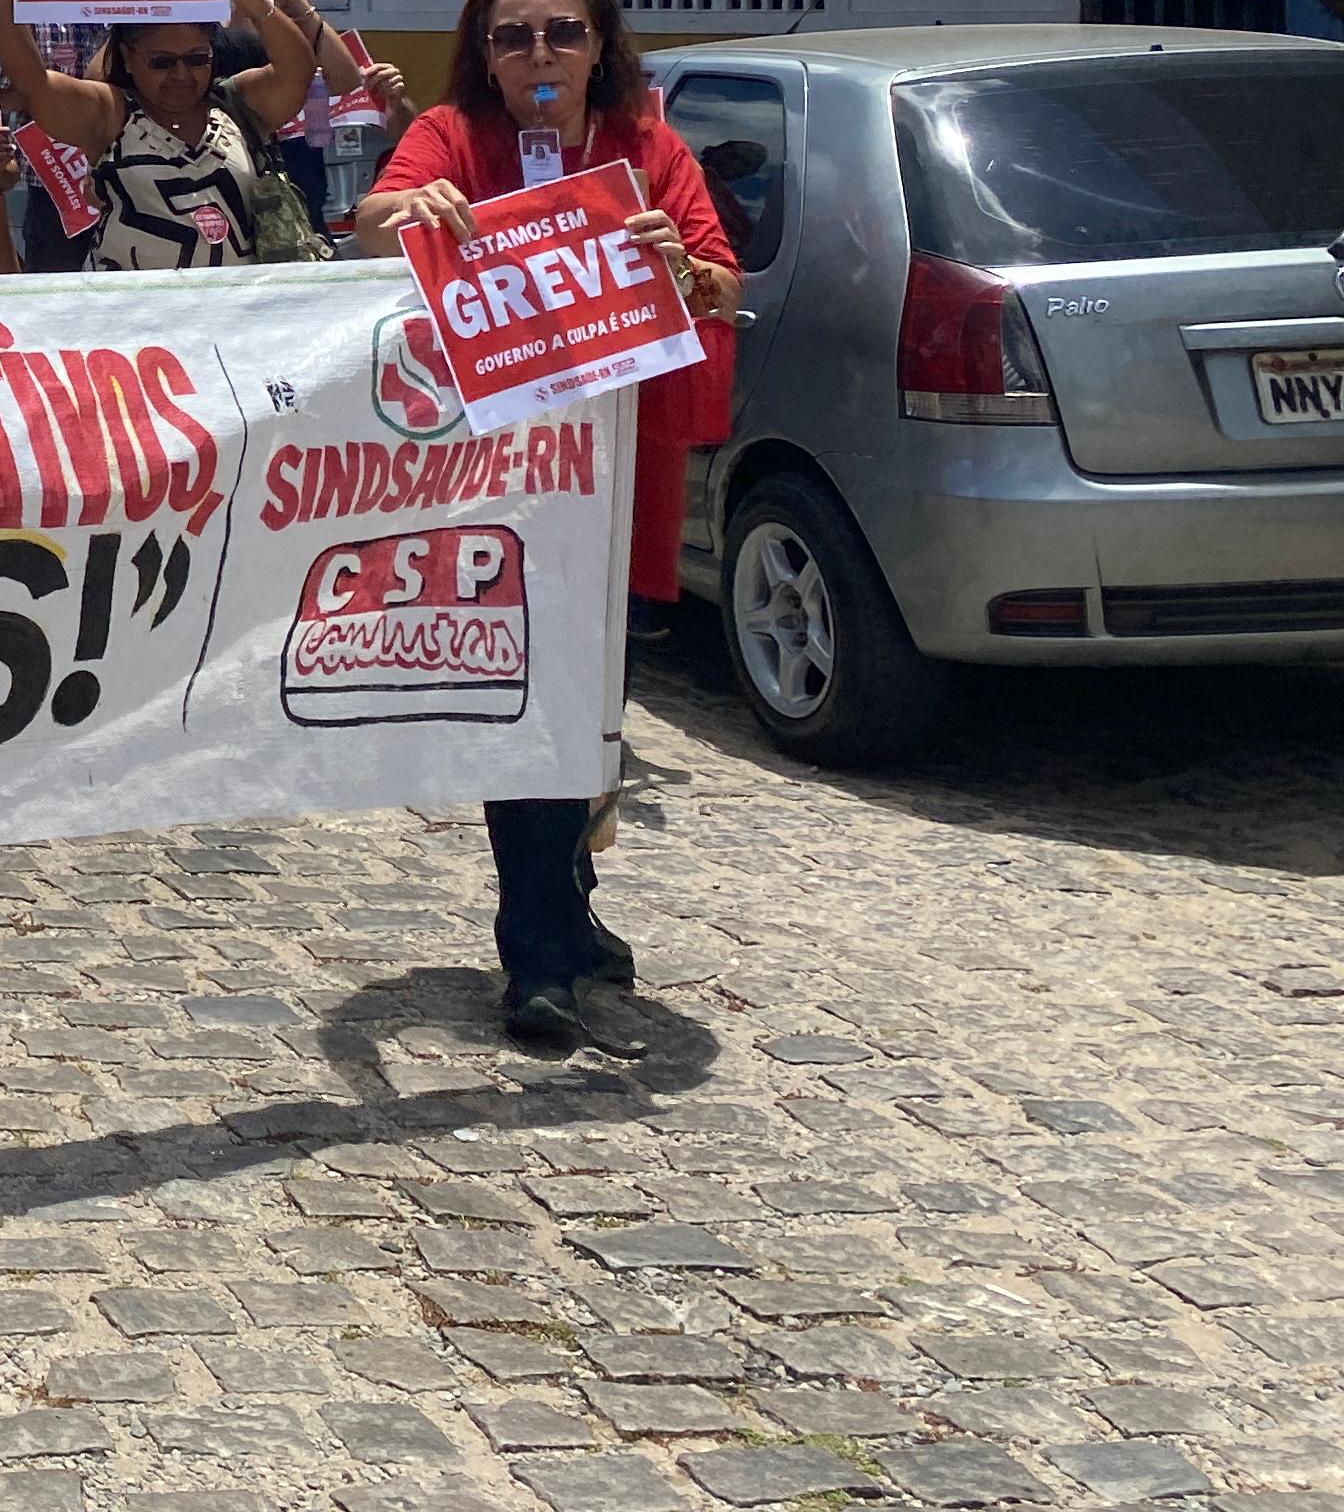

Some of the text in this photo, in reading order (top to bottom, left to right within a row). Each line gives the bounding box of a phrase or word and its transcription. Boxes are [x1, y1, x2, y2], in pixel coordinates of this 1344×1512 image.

[459, 208, 588, 263] ESTAMOS EM
[441, 229, 655, 339] GREVE
[1047, 296, 1110, 320] Palio
[475, 339, 547, 376] GOVERNO
[552, 333, 566, 351] A
[566, 320, 608, 346] CULPA
[621, 303, 657, 329] SUA!
